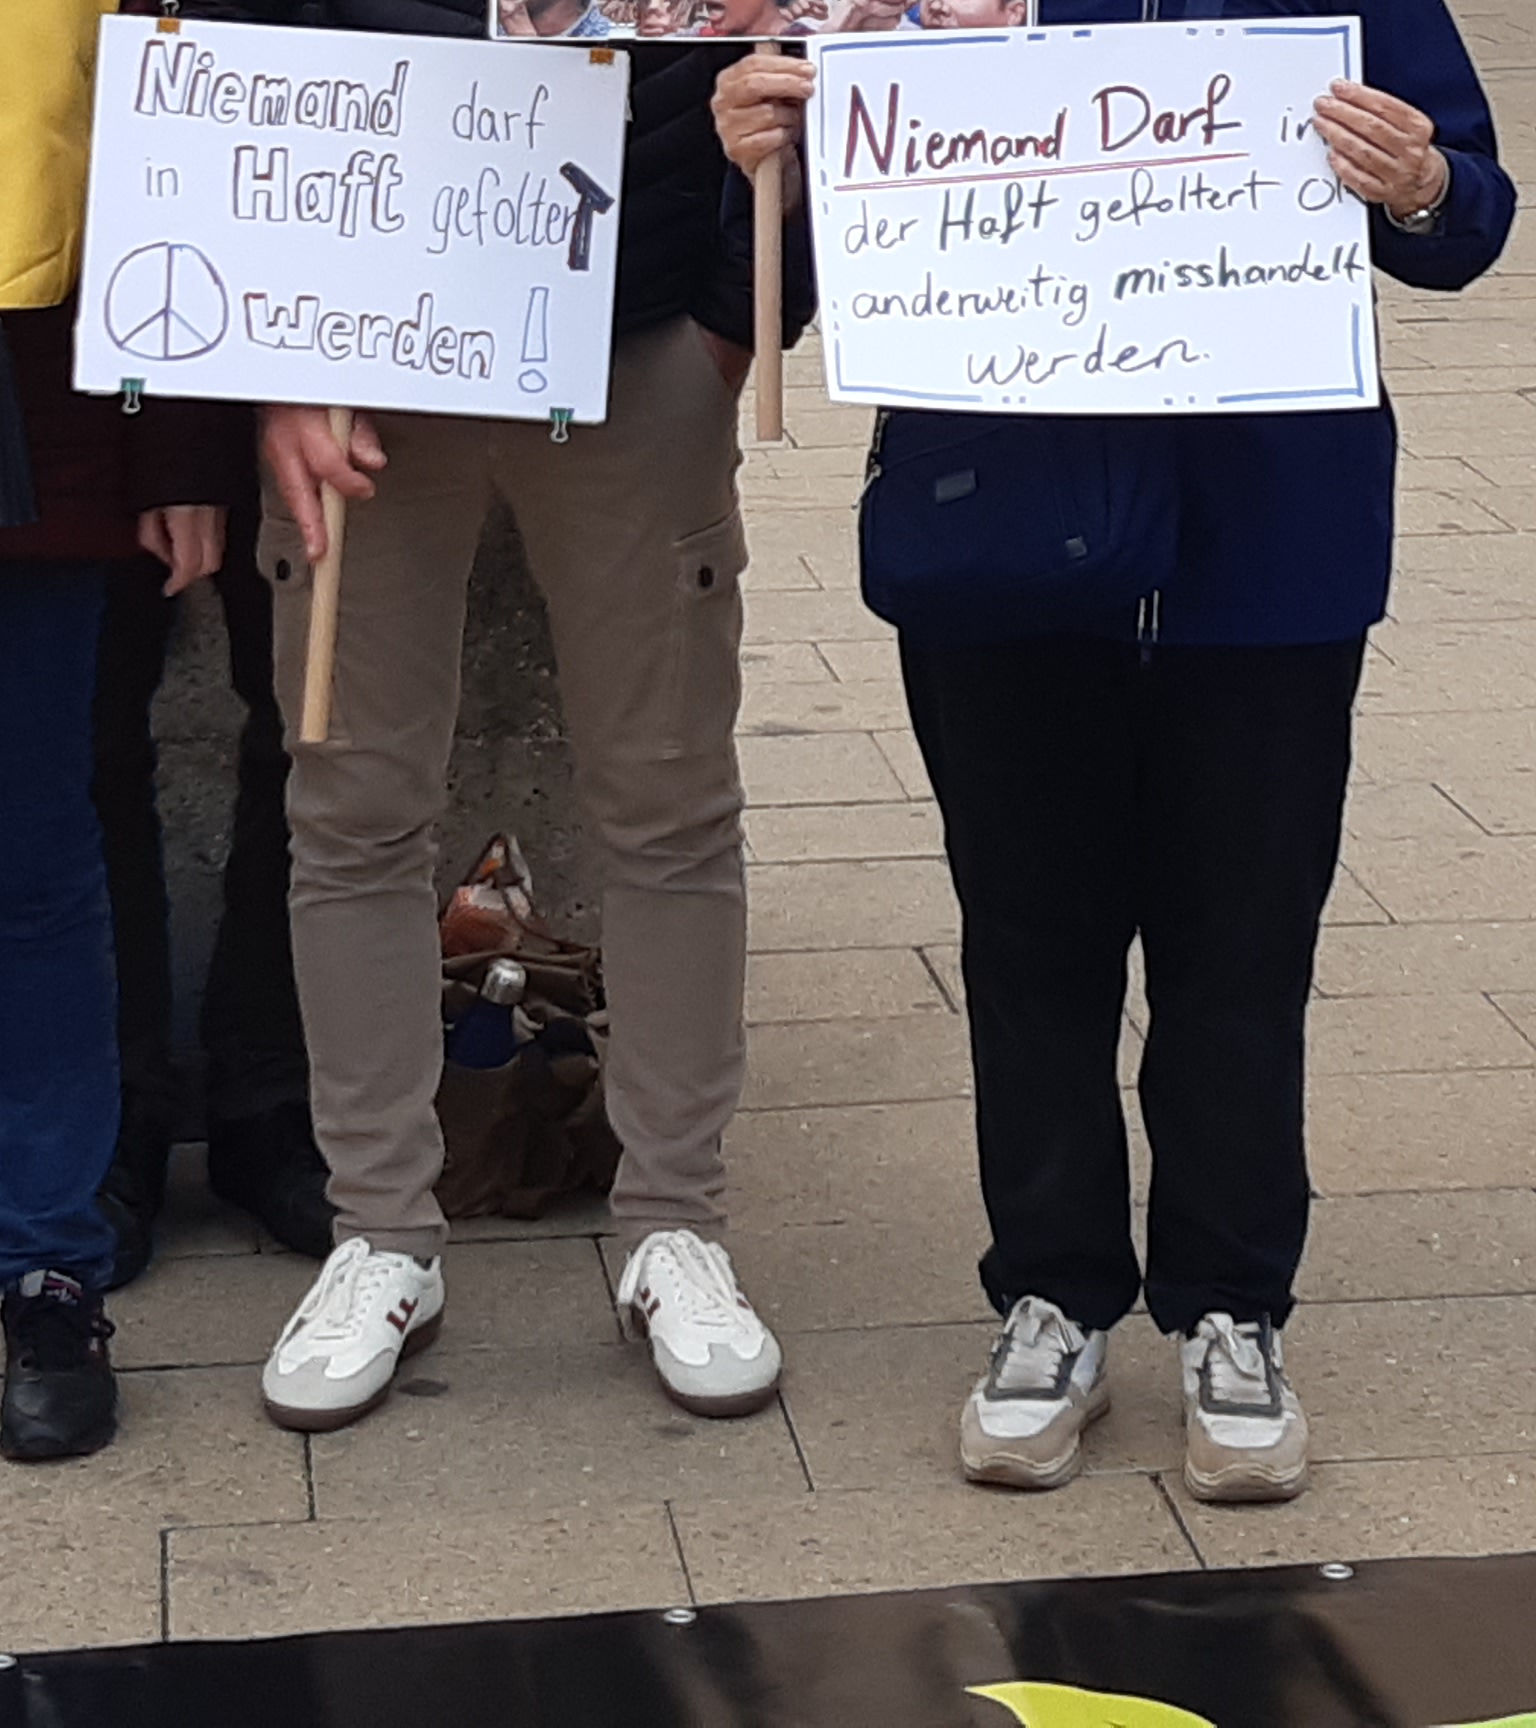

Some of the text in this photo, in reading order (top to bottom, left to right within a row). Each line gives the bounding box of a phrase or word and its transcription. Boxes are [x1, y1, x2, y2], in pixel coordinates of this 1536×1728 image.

[134, 38, 550, 150] Niemand darf
[843, 83, 1067, 177] Niemand
[1092, 74, 1243, 152] Darf
[145, 156, 179, 198] in
[232, 144, 406, 239] Haft
[844, 199, 920, 254] der
[939, 180, 1060, 251] Haft
[1075, 167, 1284, 242] gefoltert
[852, 241, 1365, 326] anderweitig misshandelt
[967, 323, 1212, 386] werden.
